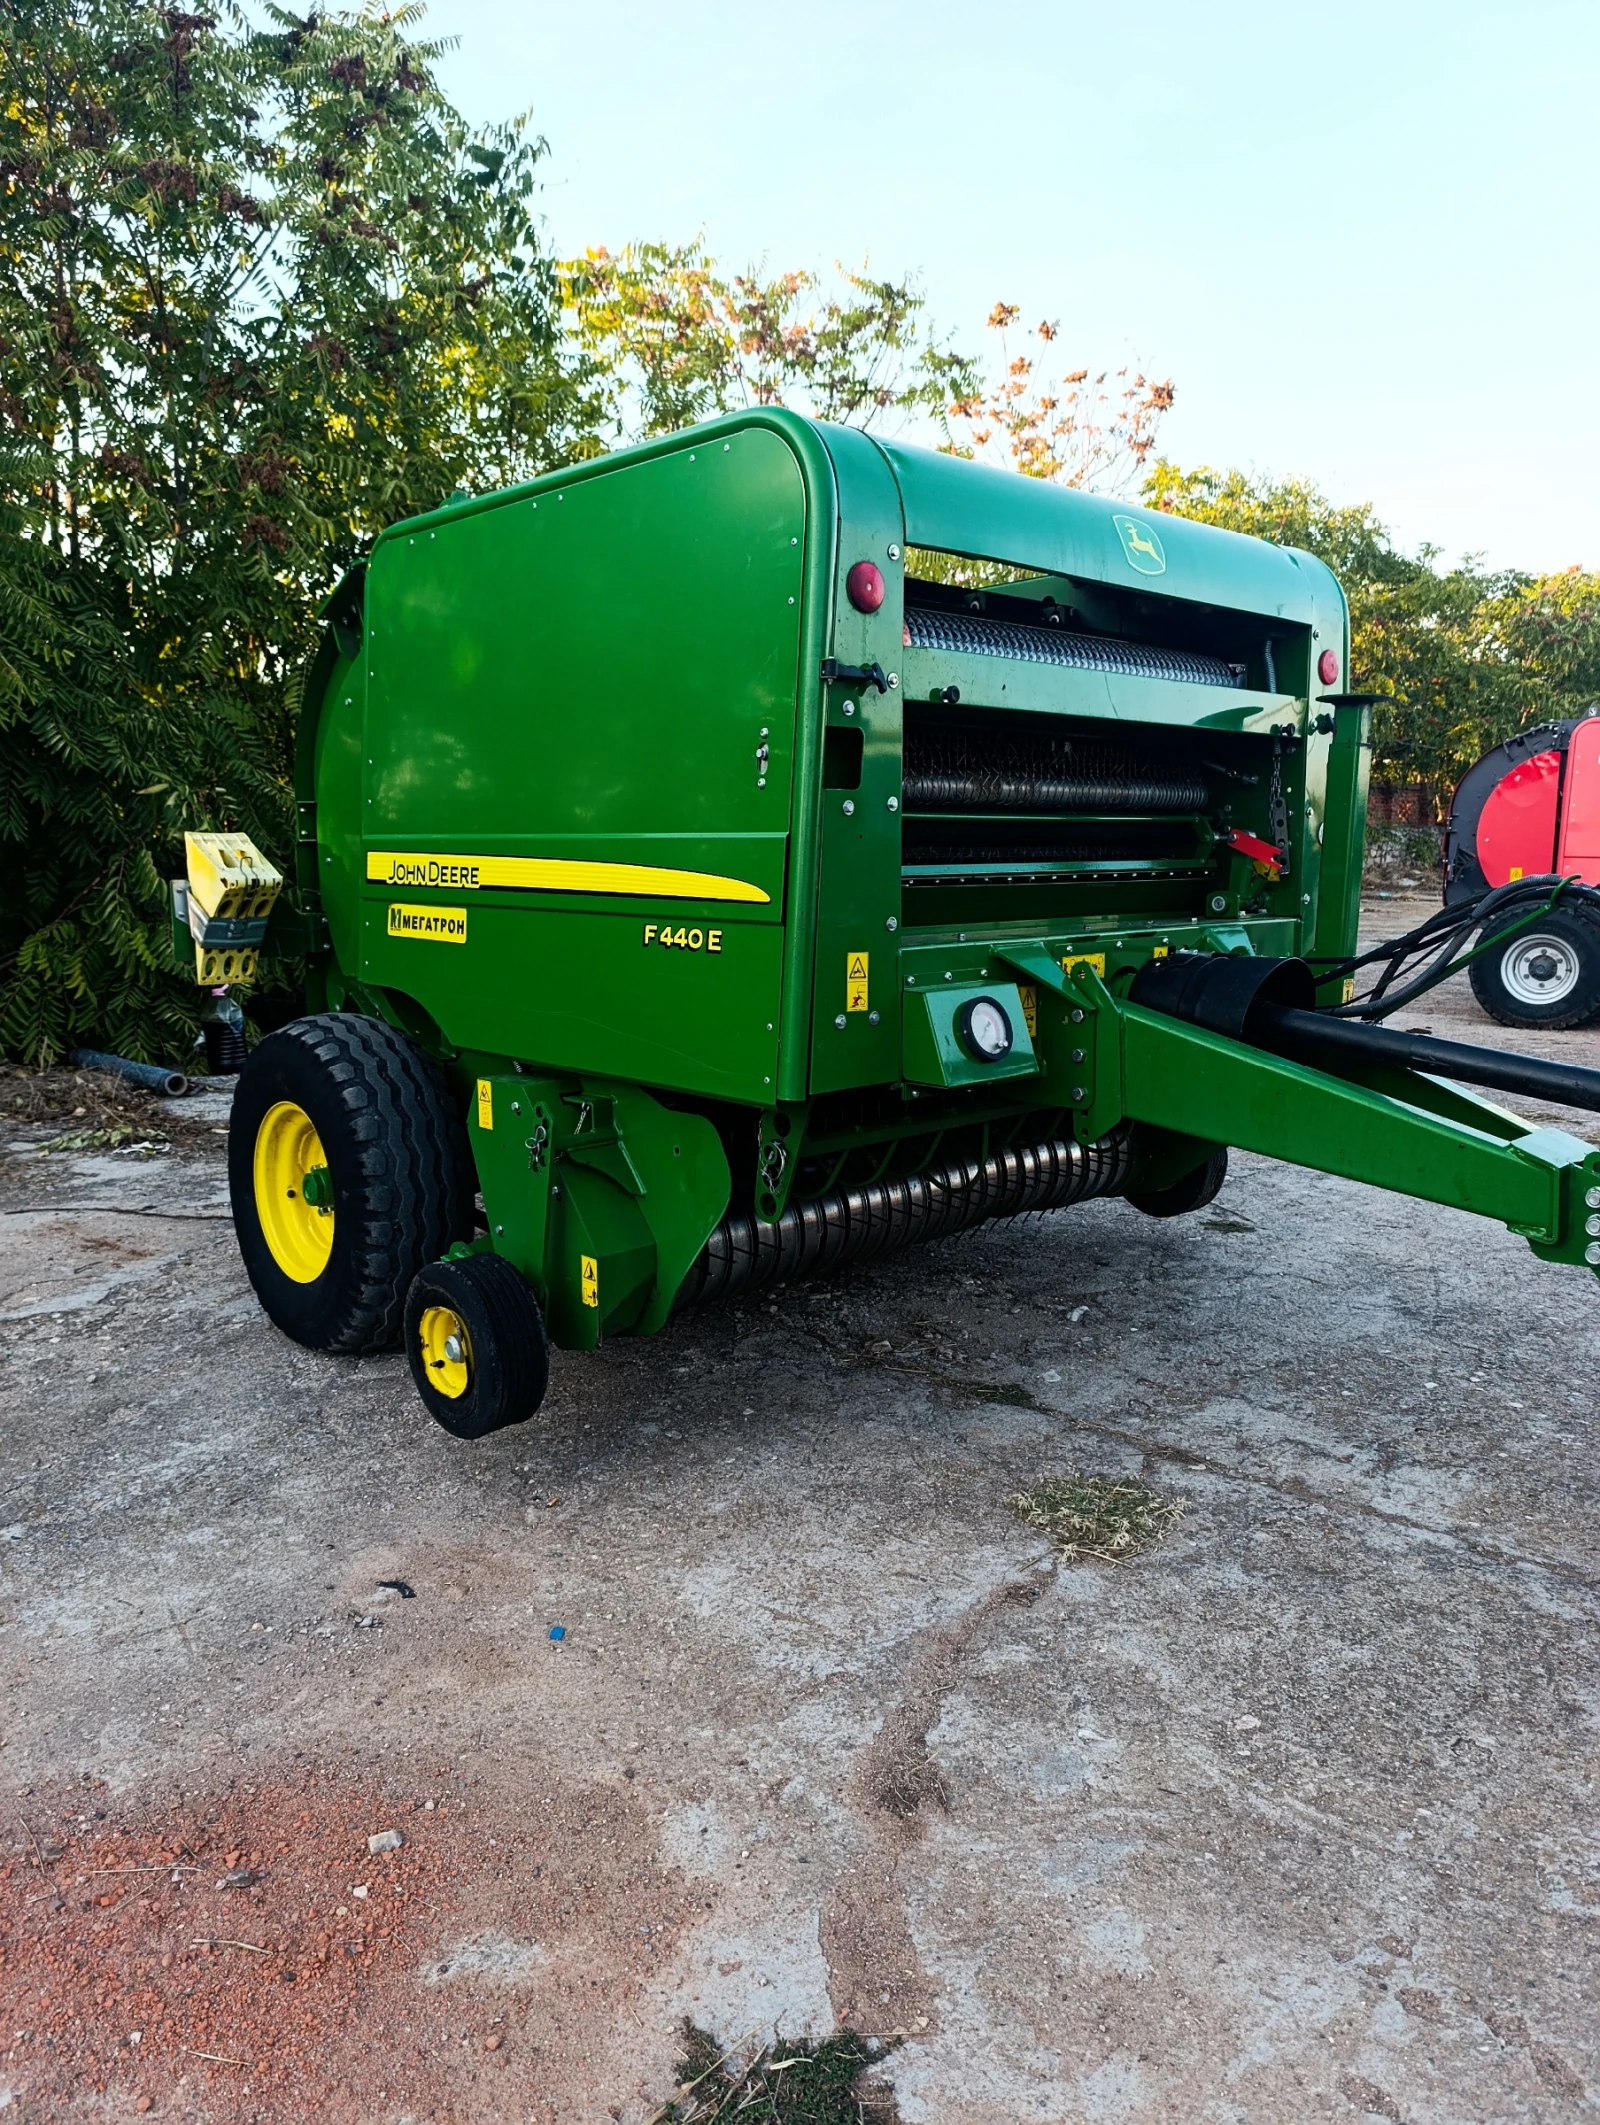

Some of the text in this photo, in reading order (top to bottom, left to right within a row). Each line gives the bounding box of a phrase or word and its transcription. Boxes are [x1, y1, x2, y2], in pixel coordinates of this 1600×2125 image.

[388, 860, 480, 885] JOHN DEERE
[402, 915, 465, 935] МЕГАТРОН
